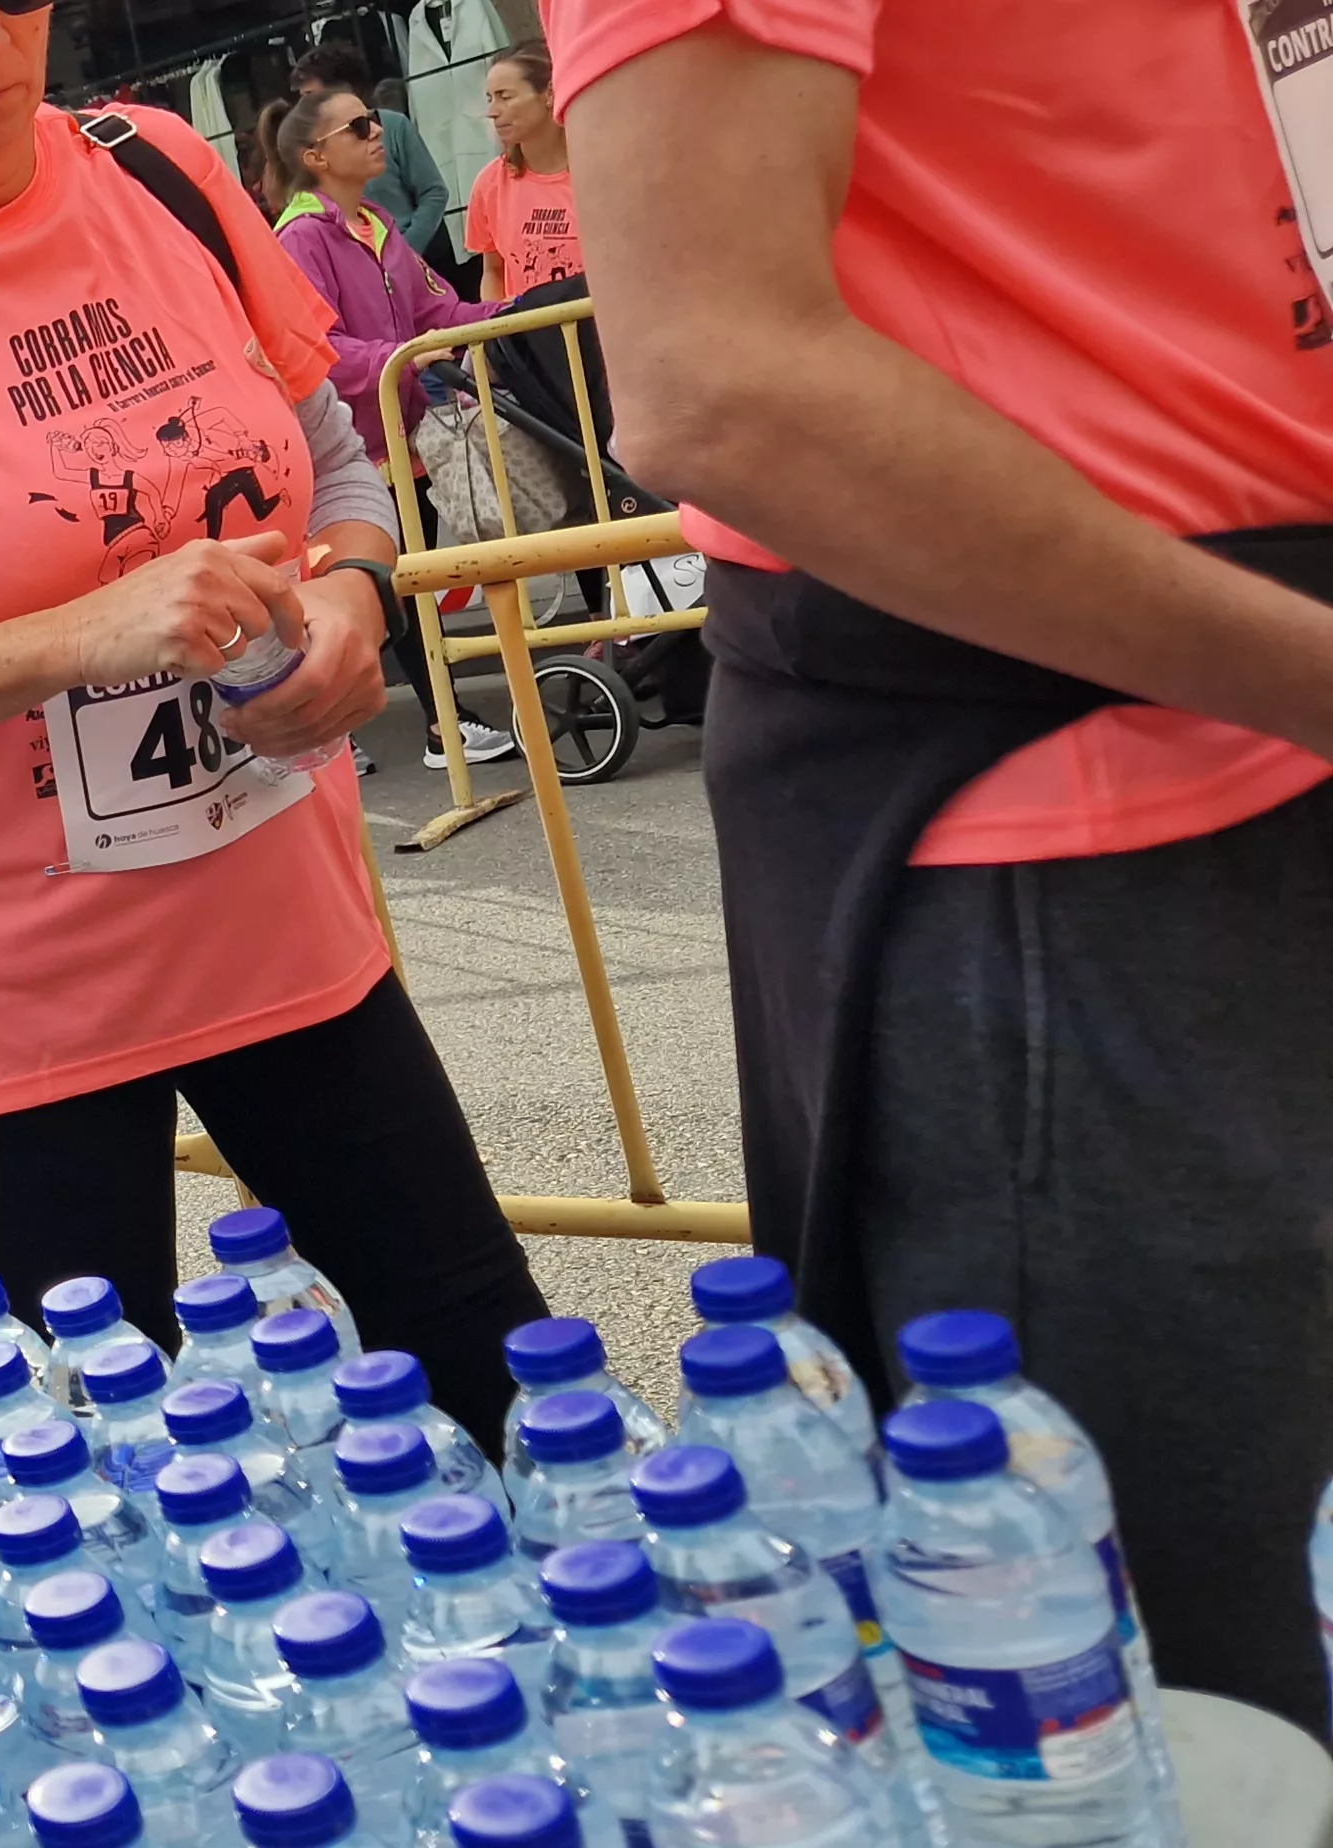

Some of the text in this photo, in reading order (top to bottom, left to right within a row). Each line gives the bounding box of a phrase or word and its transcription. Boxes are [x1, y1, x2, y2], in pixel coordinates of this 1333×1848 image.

[1267, 14, 1333, 73] CONTR
[8, 297, 133, 378] CORRAMOS
[7, 326, 176, 427] POR LA CIENCIA
[99, 491, 118, 512] 19
[114, 832, 137, 844] hoya
[149, 824, 180, 838] huesca
